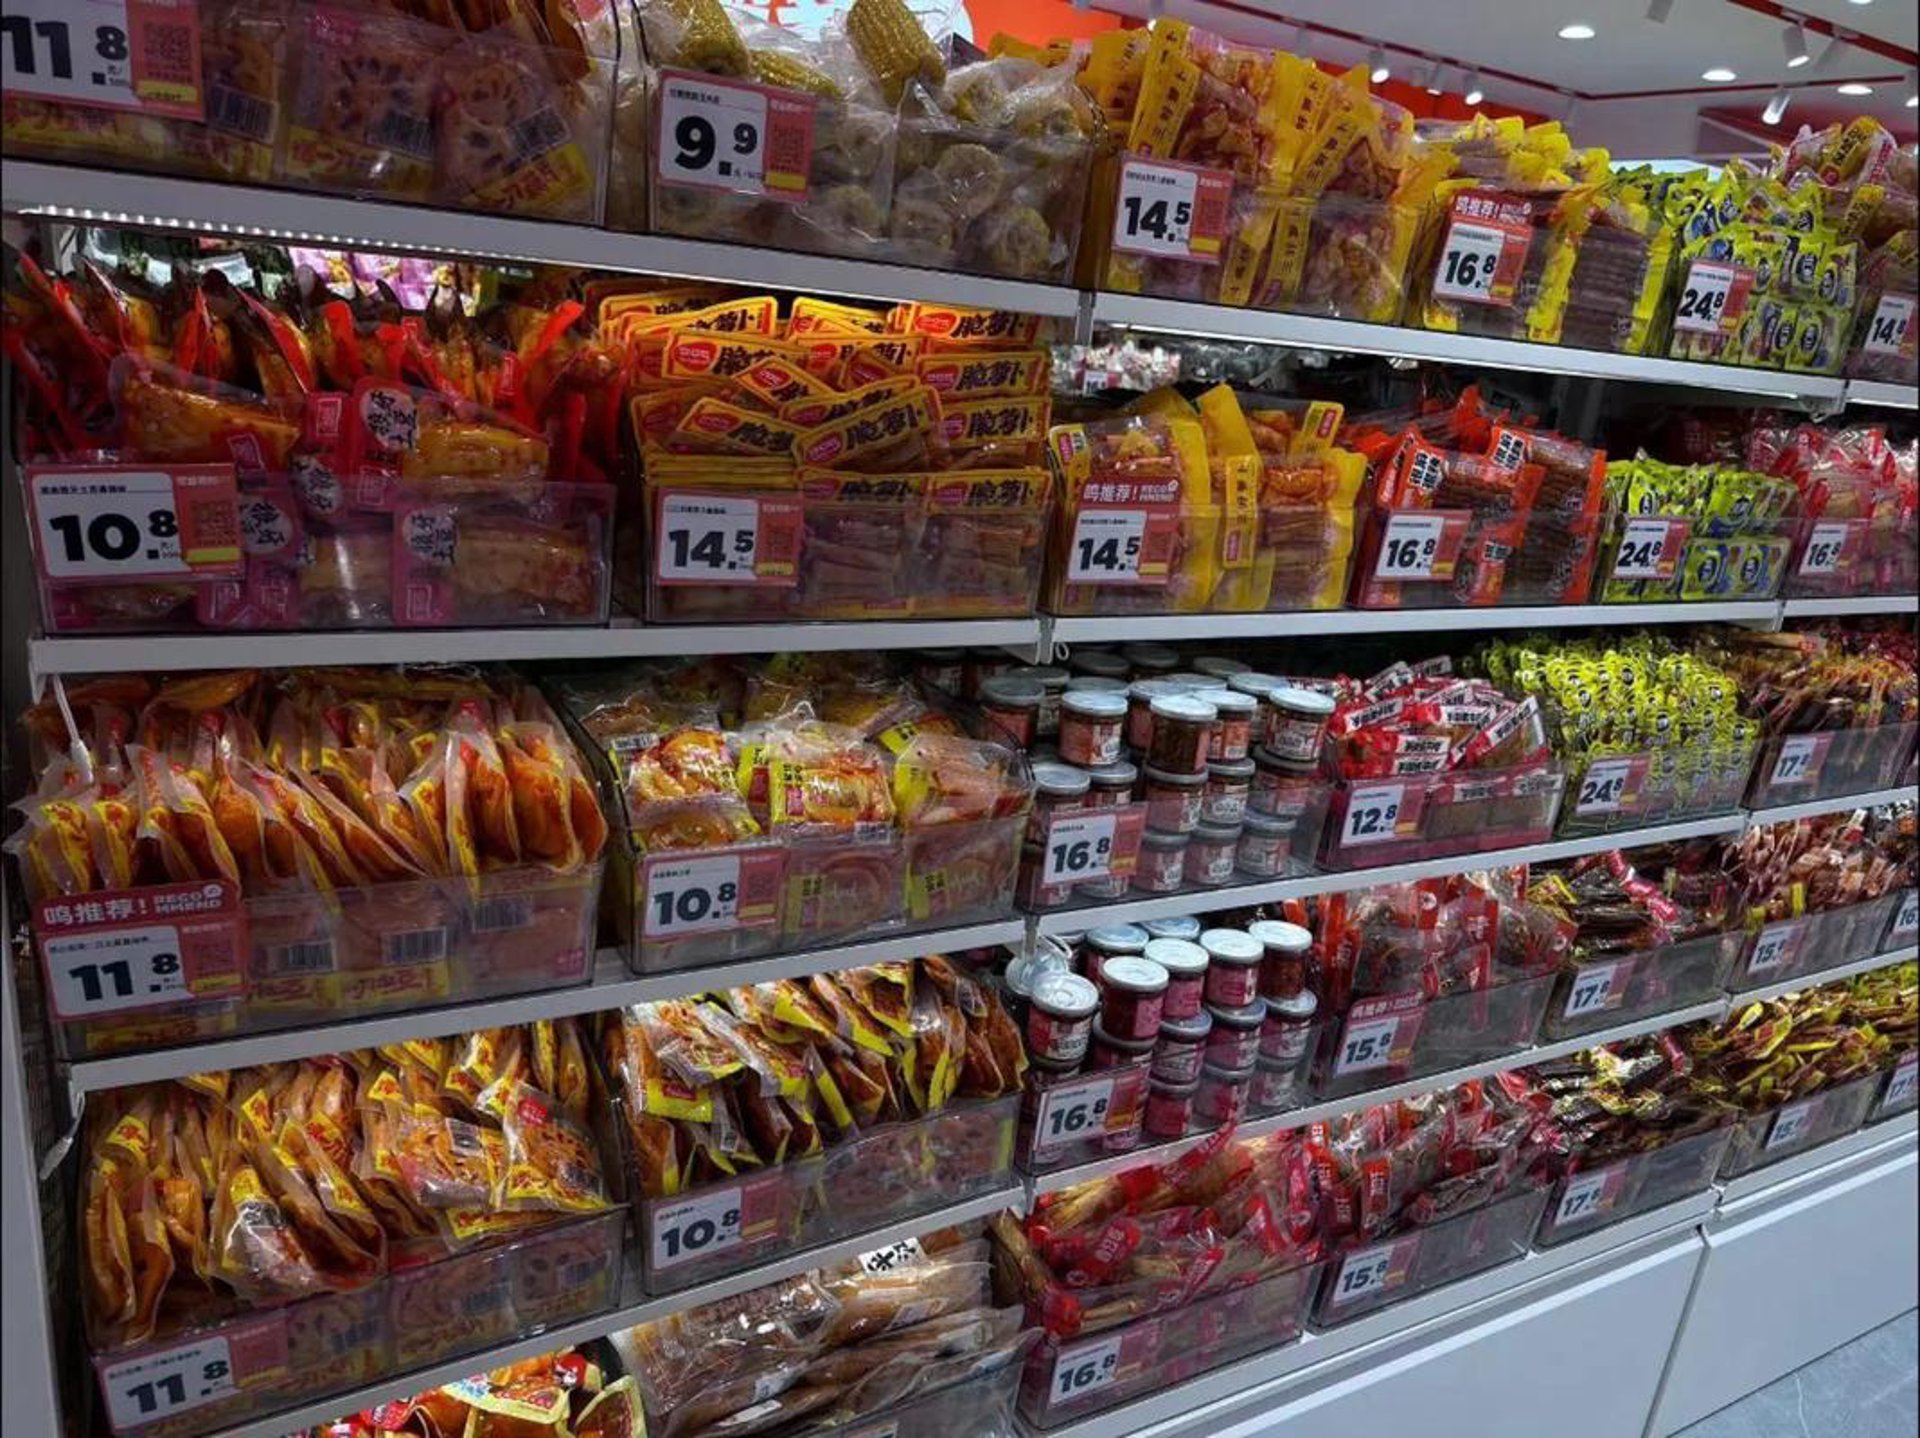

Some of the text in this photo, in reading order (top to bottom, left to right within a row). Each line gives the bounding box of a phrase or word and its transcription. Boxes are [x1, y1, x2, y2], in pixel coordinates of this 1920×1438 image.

[0, 15, 129, 85] 11.8
[674, 115, 758, 176] 9.9
[1124, 196, 1191, 243] 14.5
[1444, 251, 1497, 289] 16.8
[1678, 288, 1725, 322] 24.8
[50, 509, 178, 561] 10.8
[668, 530, 754, 570] 14.5
[1078, 535, 1141, 572] 14.5
[1386, 538, 1437, 569] 16.8
[1616, 541, 1662, 568] 24.8
[1580, 778, 1624, 804] 24.8
[1350, 804, 1398, 837] 12.8
[1052, 836, 1110, 873] 16.8
[42, 898, 148, 925] 鸣推荐！
[653, 881, 737, 925] 10.8
[69, 953, 181, 1001] 11.8
[1050, 1098, 1109, 1137] 16.8
[661, 1207, 741, 1257] 10.8
[126, 1359, 230, 1414] 11.8
[1058, 1351, 1116, 1394] 16.8
